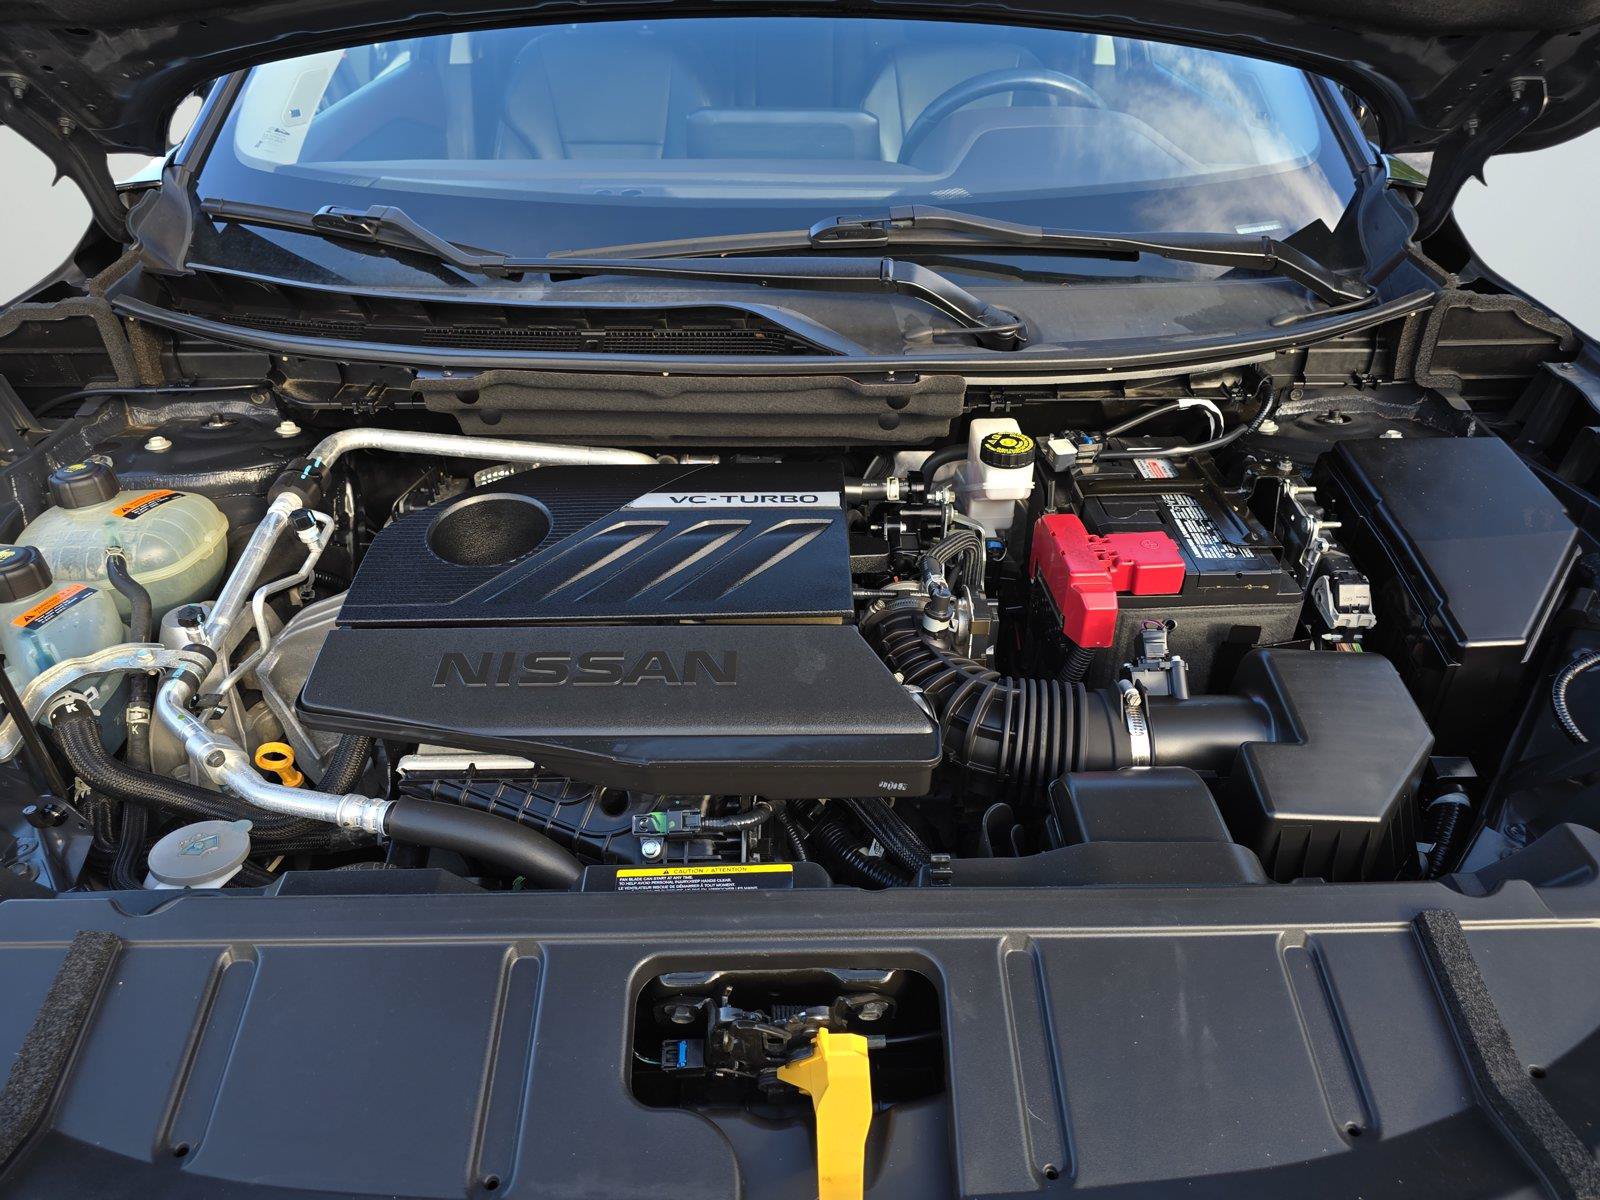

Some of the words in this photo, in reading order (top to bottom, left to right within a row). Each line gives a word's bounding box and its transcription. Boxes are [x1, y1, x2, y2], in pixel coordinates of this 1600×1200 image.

[432, 650, 738, 687] NISSAN
[65, 703, 79, 713] K
[131, 724, 139, 735] K
